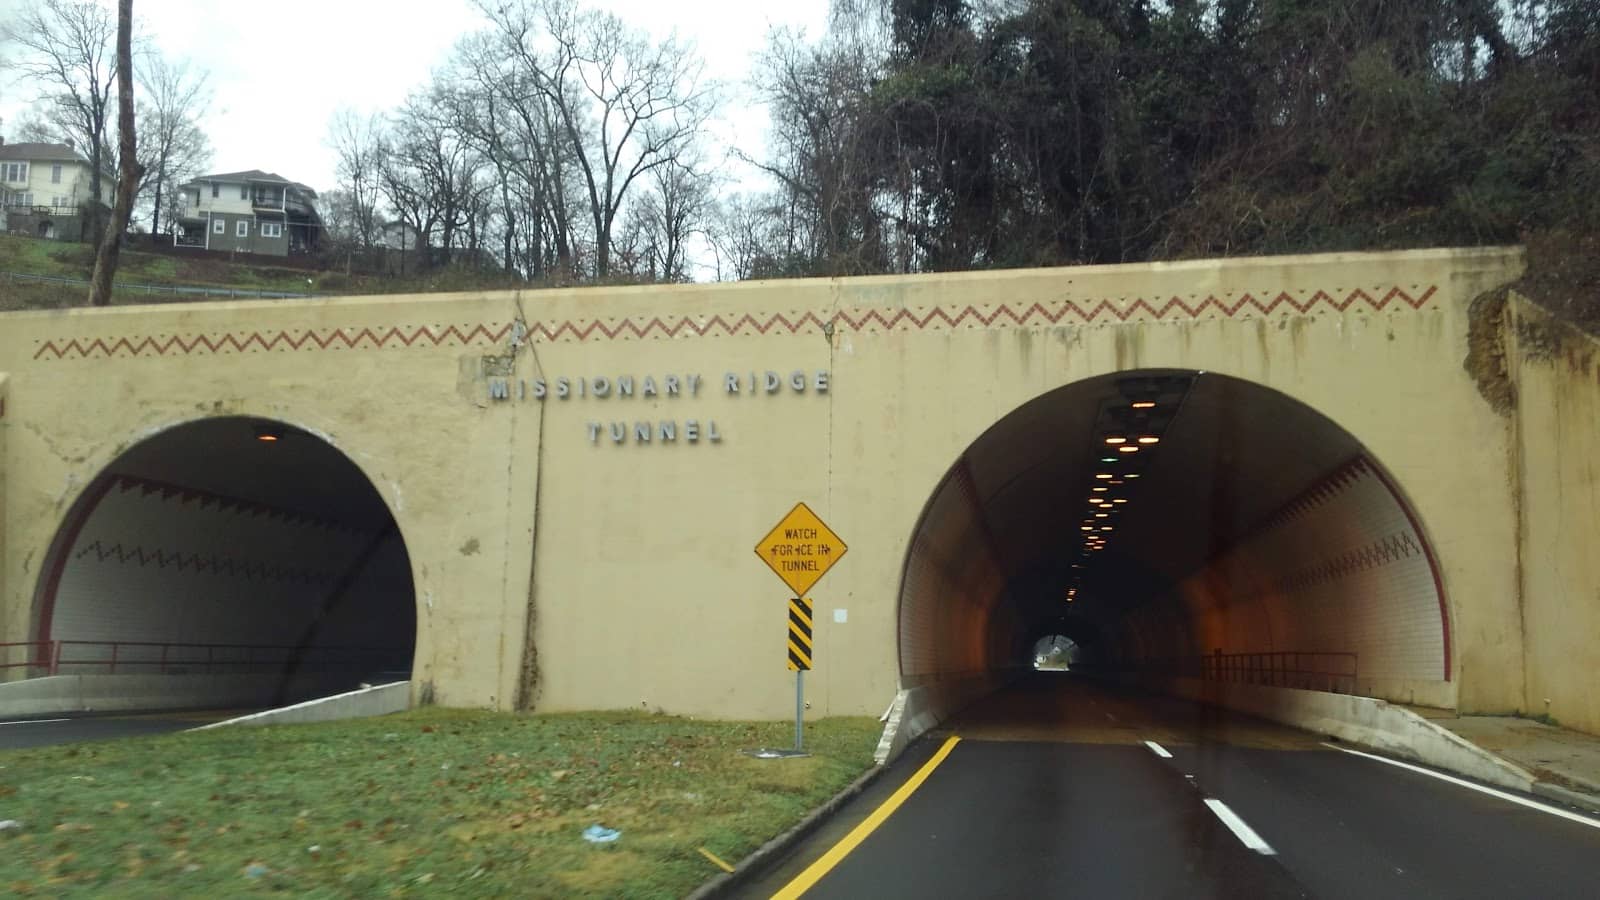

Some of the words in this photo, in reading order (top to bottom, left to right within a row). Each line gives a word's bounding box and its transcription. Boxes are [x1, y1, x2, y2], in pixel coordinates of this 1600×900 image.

[488, 374, 701, 399] MISSIONARY
[725, 370, 830, 392] RIDGE
[586, 420, 723, 442] TUNNEL
[785, 529, 817, 540] WATCH
[773, 544, 793, 556] FOR
[797, 544, 814, 556] ICE
[817, 544, 829, 556] IN
[781, 560, 820, 572] TUNNEL
